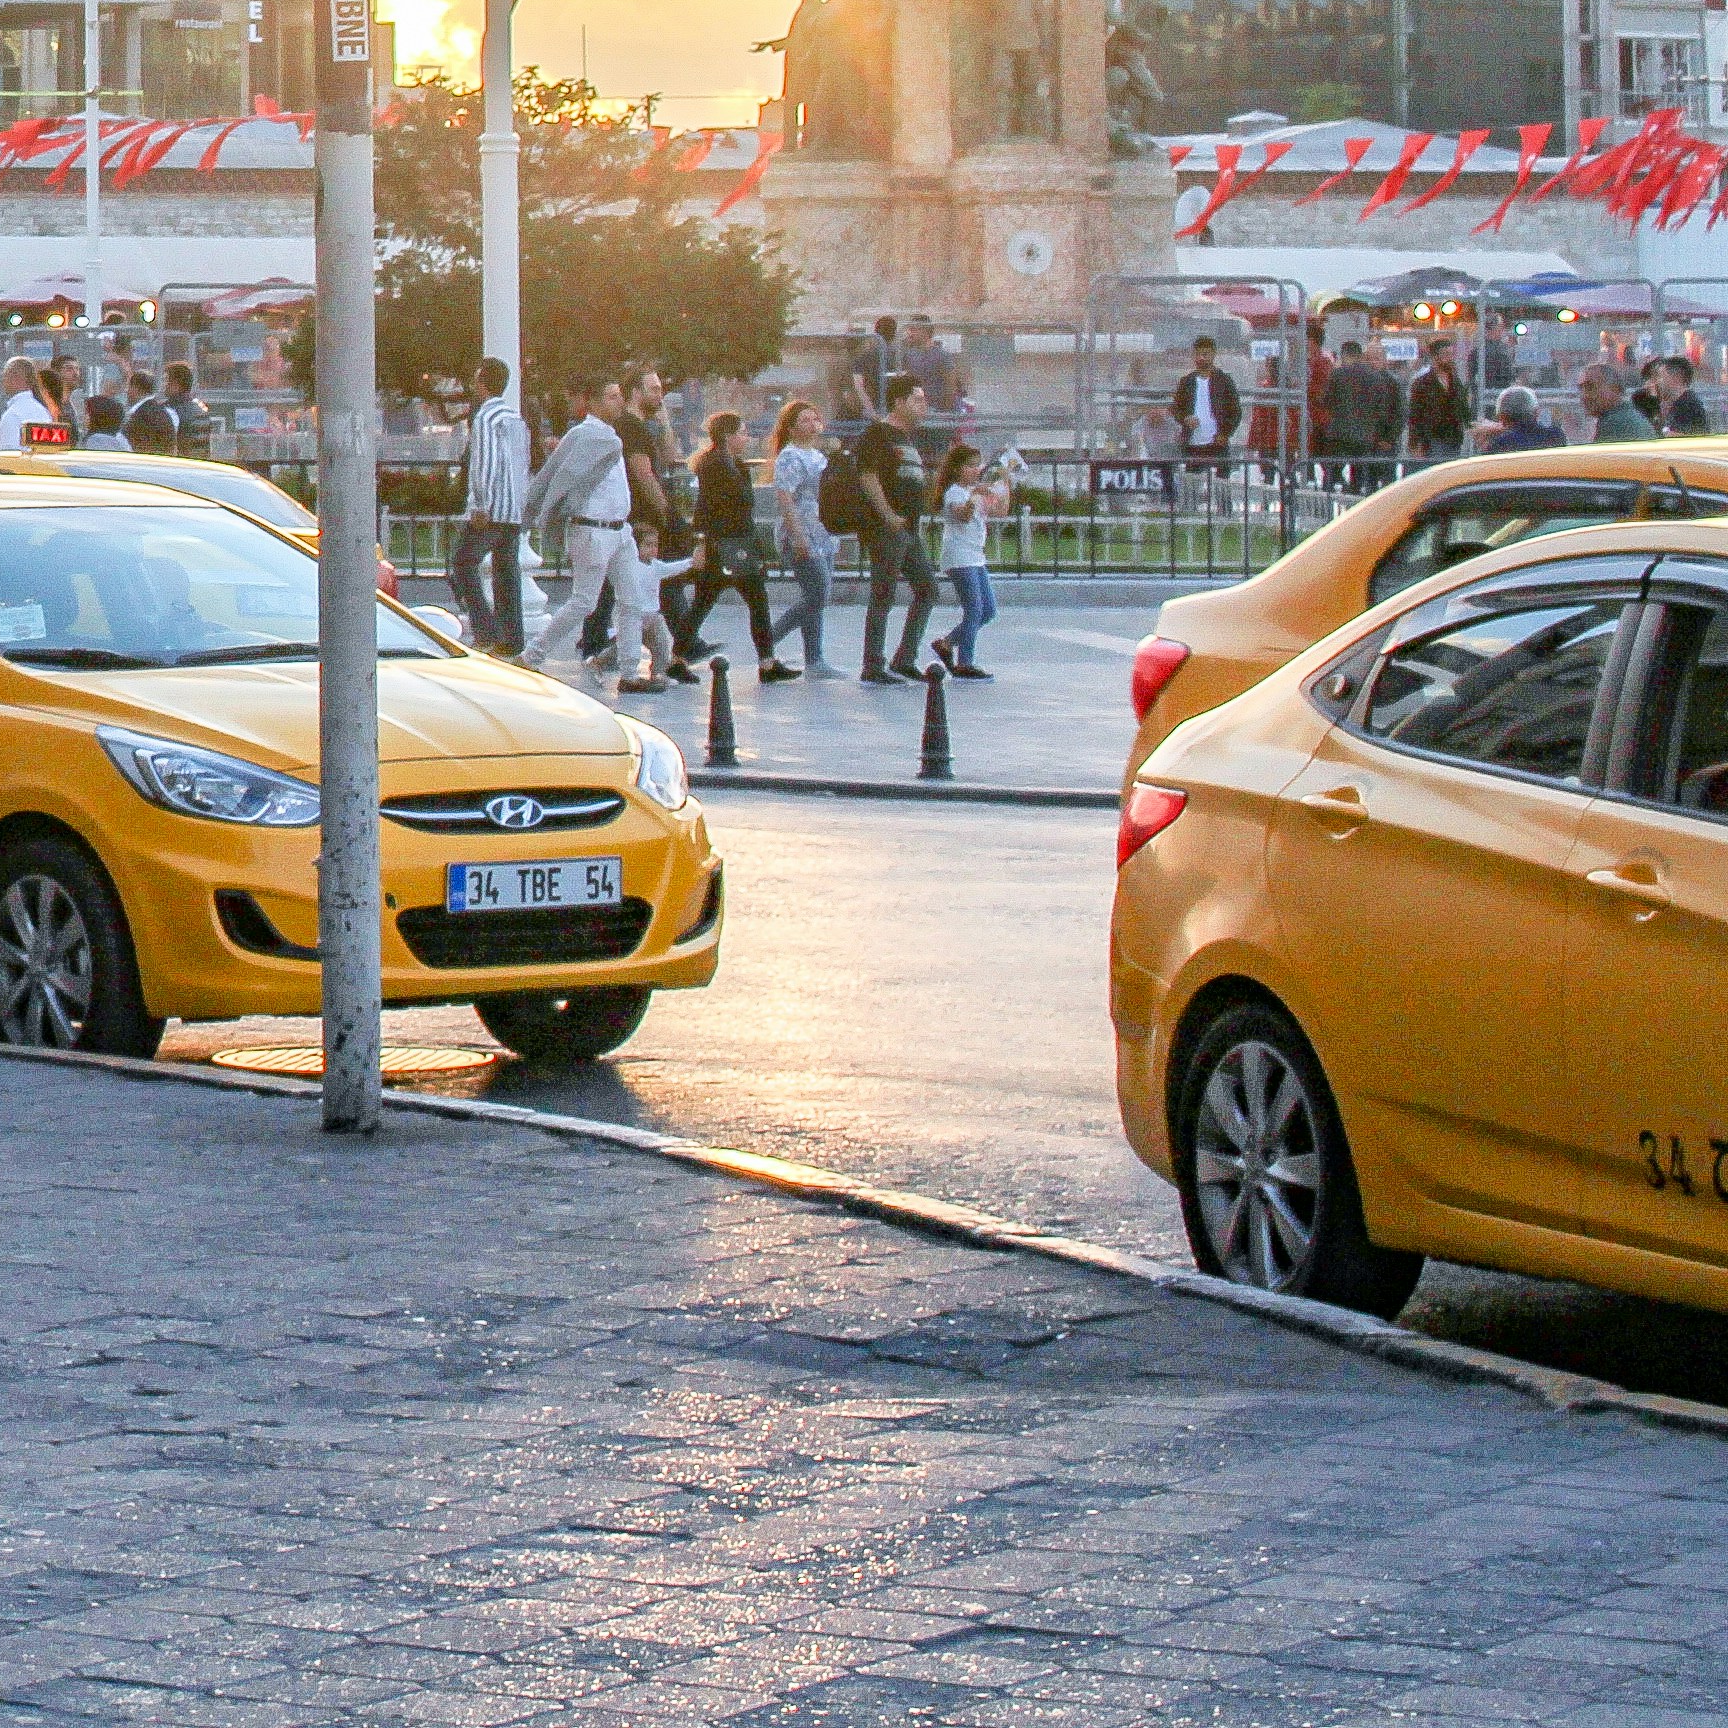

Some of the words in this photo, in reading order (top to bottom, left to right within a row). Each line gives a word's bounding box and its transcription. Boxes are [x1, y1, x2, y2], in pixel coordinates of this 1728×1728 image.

[31, 426, 69, 443] TAXI
[469, 870, 499, 906] 34
[518, 867, 562, 903] TBE
[586, 865, 613, 900] 54
[1639, 1129, 1696, 1197] 34
